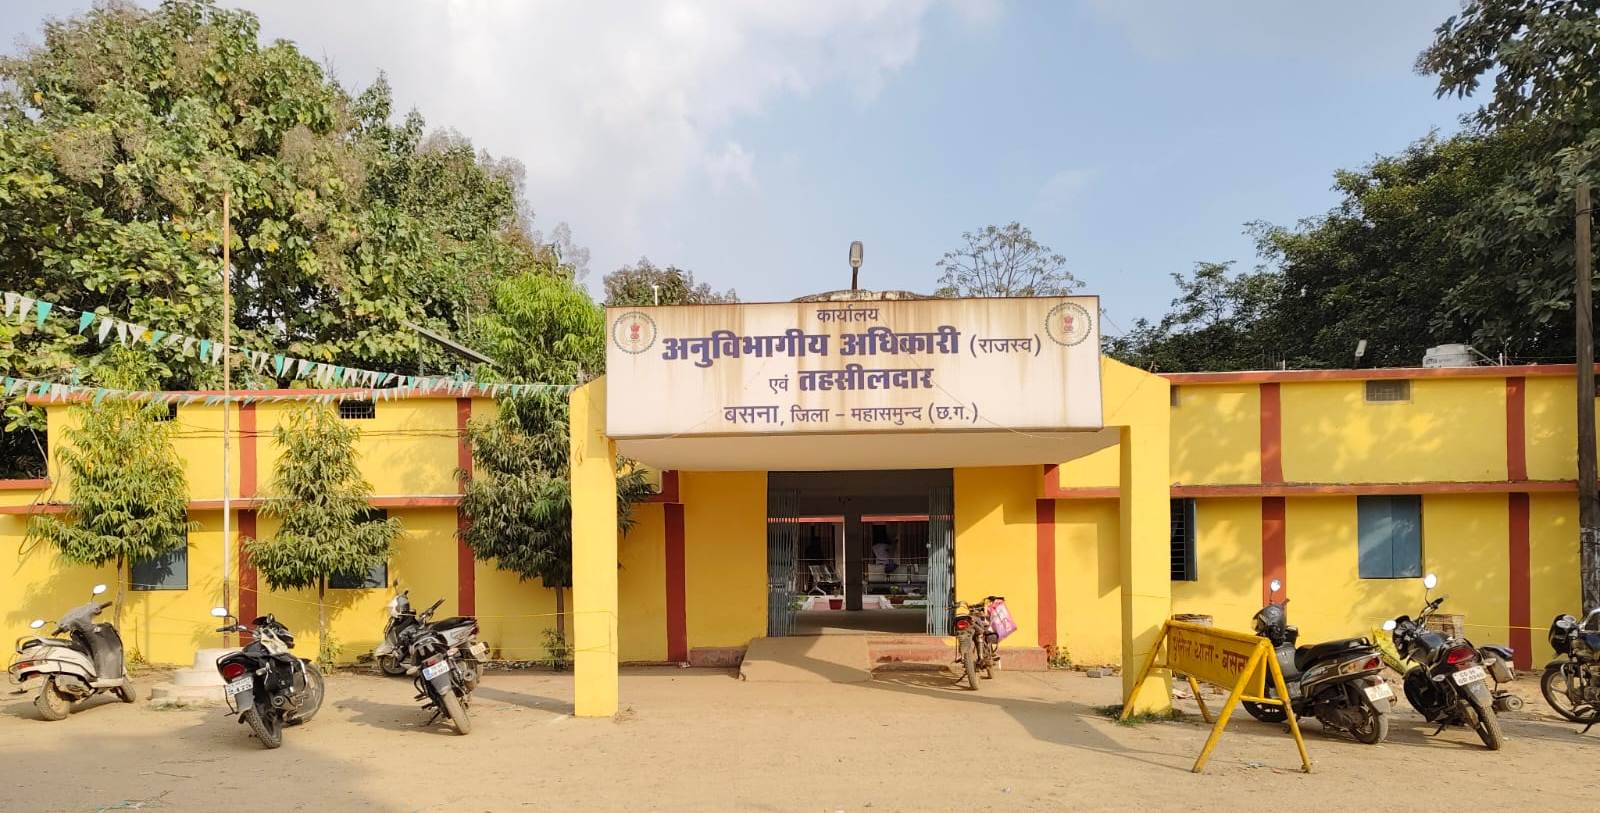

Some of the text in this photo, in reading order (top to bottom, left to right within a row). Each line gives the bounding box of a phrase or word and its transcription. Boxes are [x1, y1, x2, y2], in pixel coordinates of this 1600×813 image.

[817, 304, 879, 323] कार्यालय
[662, 325, 1042, 368] अनुविभागीय अधिकारी (राजस्व)
[769, 363, 935, 395] एवं तहसीलदार
[724, 406, 785, 427] बसना,
[790, 405, 830, 423] जिला
[850, 406, 923, 426] महासमुन्द
[928, 402, 979, 424] (छ.ग.)
